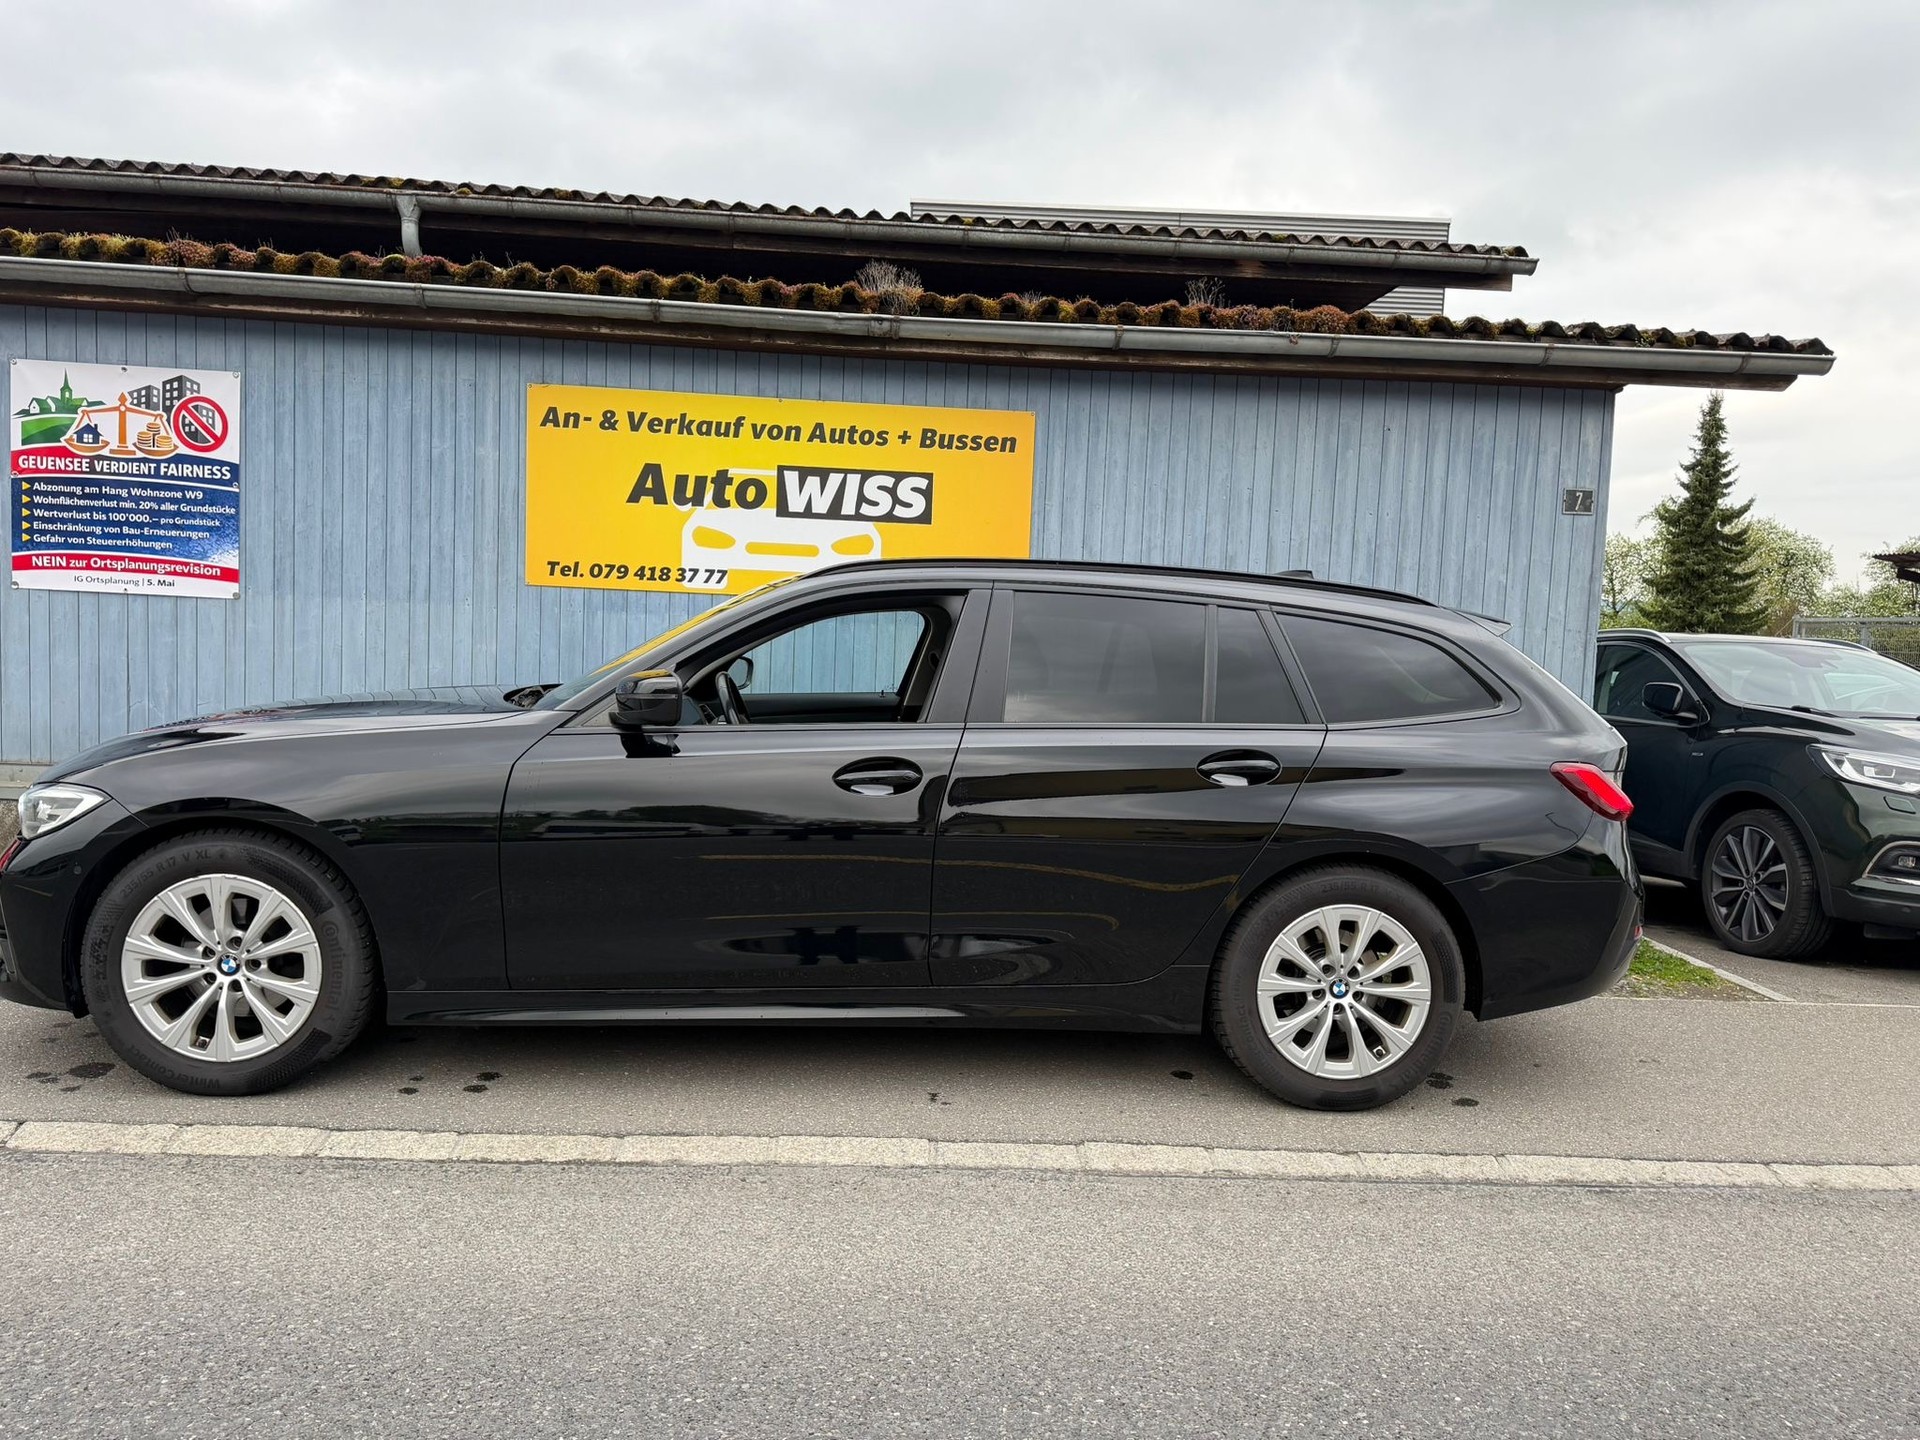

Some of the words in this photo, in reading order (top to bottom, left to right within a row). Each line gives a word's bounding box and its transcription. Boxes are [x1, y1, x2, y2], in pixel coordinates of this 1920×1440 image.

[539, 406, 593, 429] An-
[598, 411, 619, 432] &
[627, 411, 745, 440] Verkauf
[751, 422, 801, 442] von
[807, 422, 889, 447] Autos
[897, 431, 911, 445] +
[919, 428, 1017, 453] Bussen
[18, 455, 90, 472] GEUENSEE
[94, 459, 157, 475] VERDIENT
[160, 463, 231, 480] FAIRNESS
[33, 482, 82, 495] Abzonung
[84, 486, 99, 494] am
[102, 486, 128, 497] Hang
[130, 487, 183, 498] Wohnzone
[185, 490, 203, 500] W9
[626, 462, 768, 510] Auto
[783, 472, 929, 518] WISS
[33, 495, 117, 508] Wohnflächenverlust
[119, 500, 137, 509] min.
[139, 501, 158, 510] 20%
[160, 502, 179, 511] aller
[180, 503, 236, 515] Grundstücke
[1575, 492, 1583, 511] 7
[33, 508, 91, 520] Wertverlust
[93, 511, 106, 520] bis
[160, 517, 174, 525] pro
[175, 517, 221, 527] Grundstück
[33, 521, 102, 535] Einschränkung
[122, 526, 210, 539] Bau-Erneuerungen
[33, 534, 65, 543] Gefahr
[86, 536, 172, 550] Steuererhöhungen
[31, 555, 67, 567] NEIN
[69, 559, 88, 567] zur
[90, 557, 220, 576] Ortsplanungsrevision
[547, 560, 585, 579] Tel.
[589, 561, 630, 581] 079
[633, 565, 672, 583] 418
[675, 566, 699, 584] 37
[704, 568, 728, 585] 77
[74, 575, 84, 583] IG
[86, 576, 139, 587] Ortsplanung
[119, 869, 154, 897] 235/55
[182, 852, 190, 862] V
[195, 849, 212, 860] XL
[320, 920, 346, 1011] Continental
